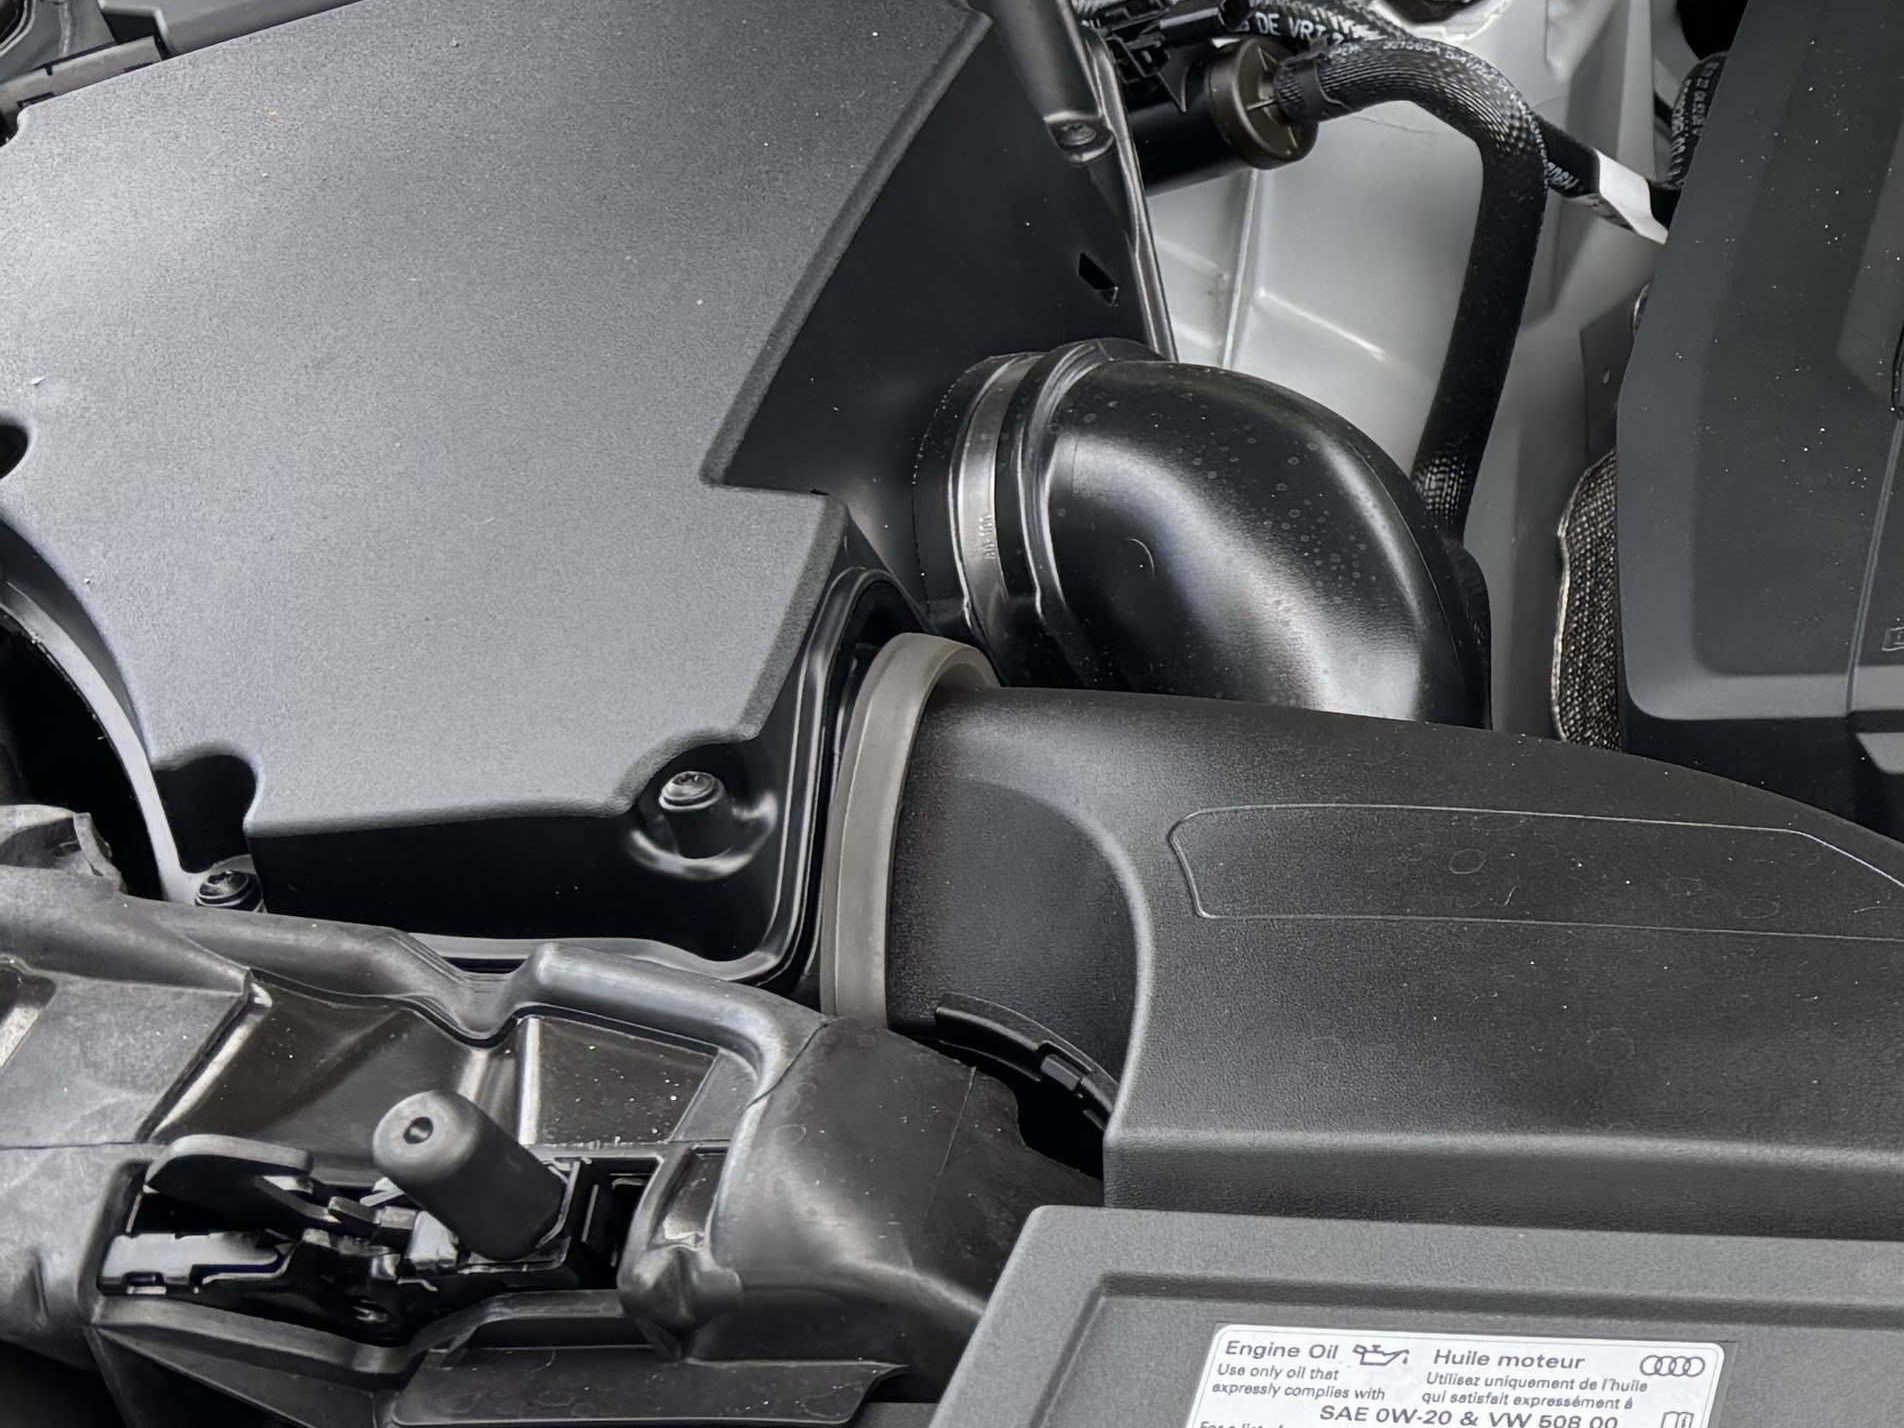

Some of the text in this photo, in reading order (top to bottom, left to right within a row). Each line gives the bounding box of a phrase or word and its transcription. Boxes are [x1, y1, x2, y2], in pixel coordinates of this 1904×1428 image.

[1225, 1341, 1585, 1369] Engine Oil Huile moteur
[1217, 1363, 1339, 1381] Use only oil that
[1427, 1372, 1479, 1387] Utilisez
[1485, 1376, 1575, 1391] uniquement
[1579, 1377, 1597, 1391] de
[1212, 1382, 1385, 1401] expressly complies with
[1422, 1392, 1445, 1407] qui
[1450, 1393, 1508, 1406] satisfait
[1513, 1395, 1620, 1410] expressément
[1320, 1405, 1369, 1422] SAE
[1376, 1408, 1452, 1425] 0W-20
[1460, 1412, 1478, 1426] &
[1489, 1412, 1532, 1428] VW
